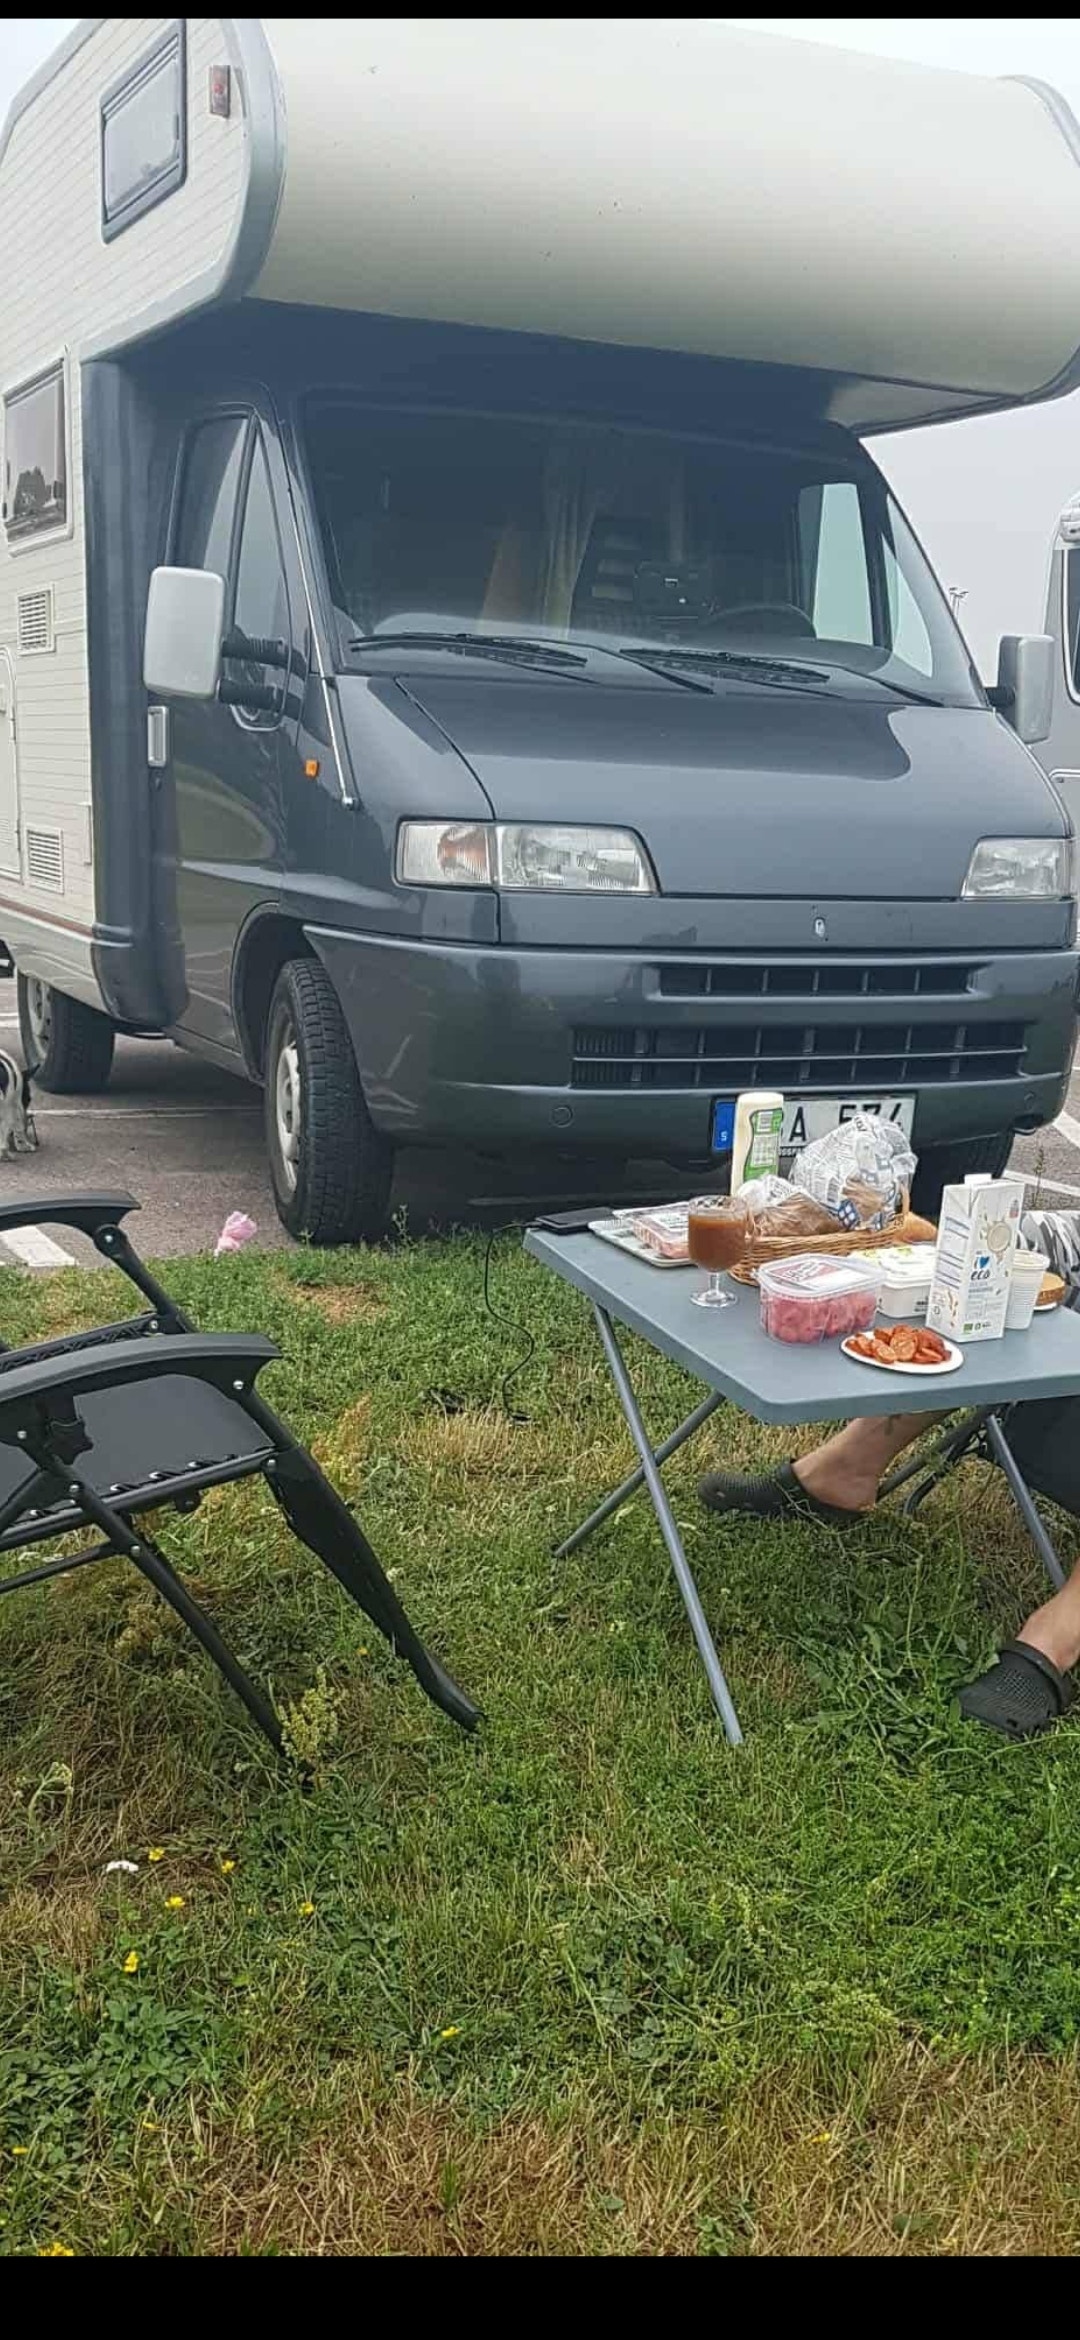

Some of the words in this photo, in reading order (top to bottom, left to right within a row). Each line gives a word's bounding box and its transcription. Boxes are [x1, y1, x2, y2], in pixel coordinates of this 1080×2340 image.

[782, 1106, 807, 1143] A
[720, 1130, 728, 1142] S
[970, 1269, 991, 1281] eco
